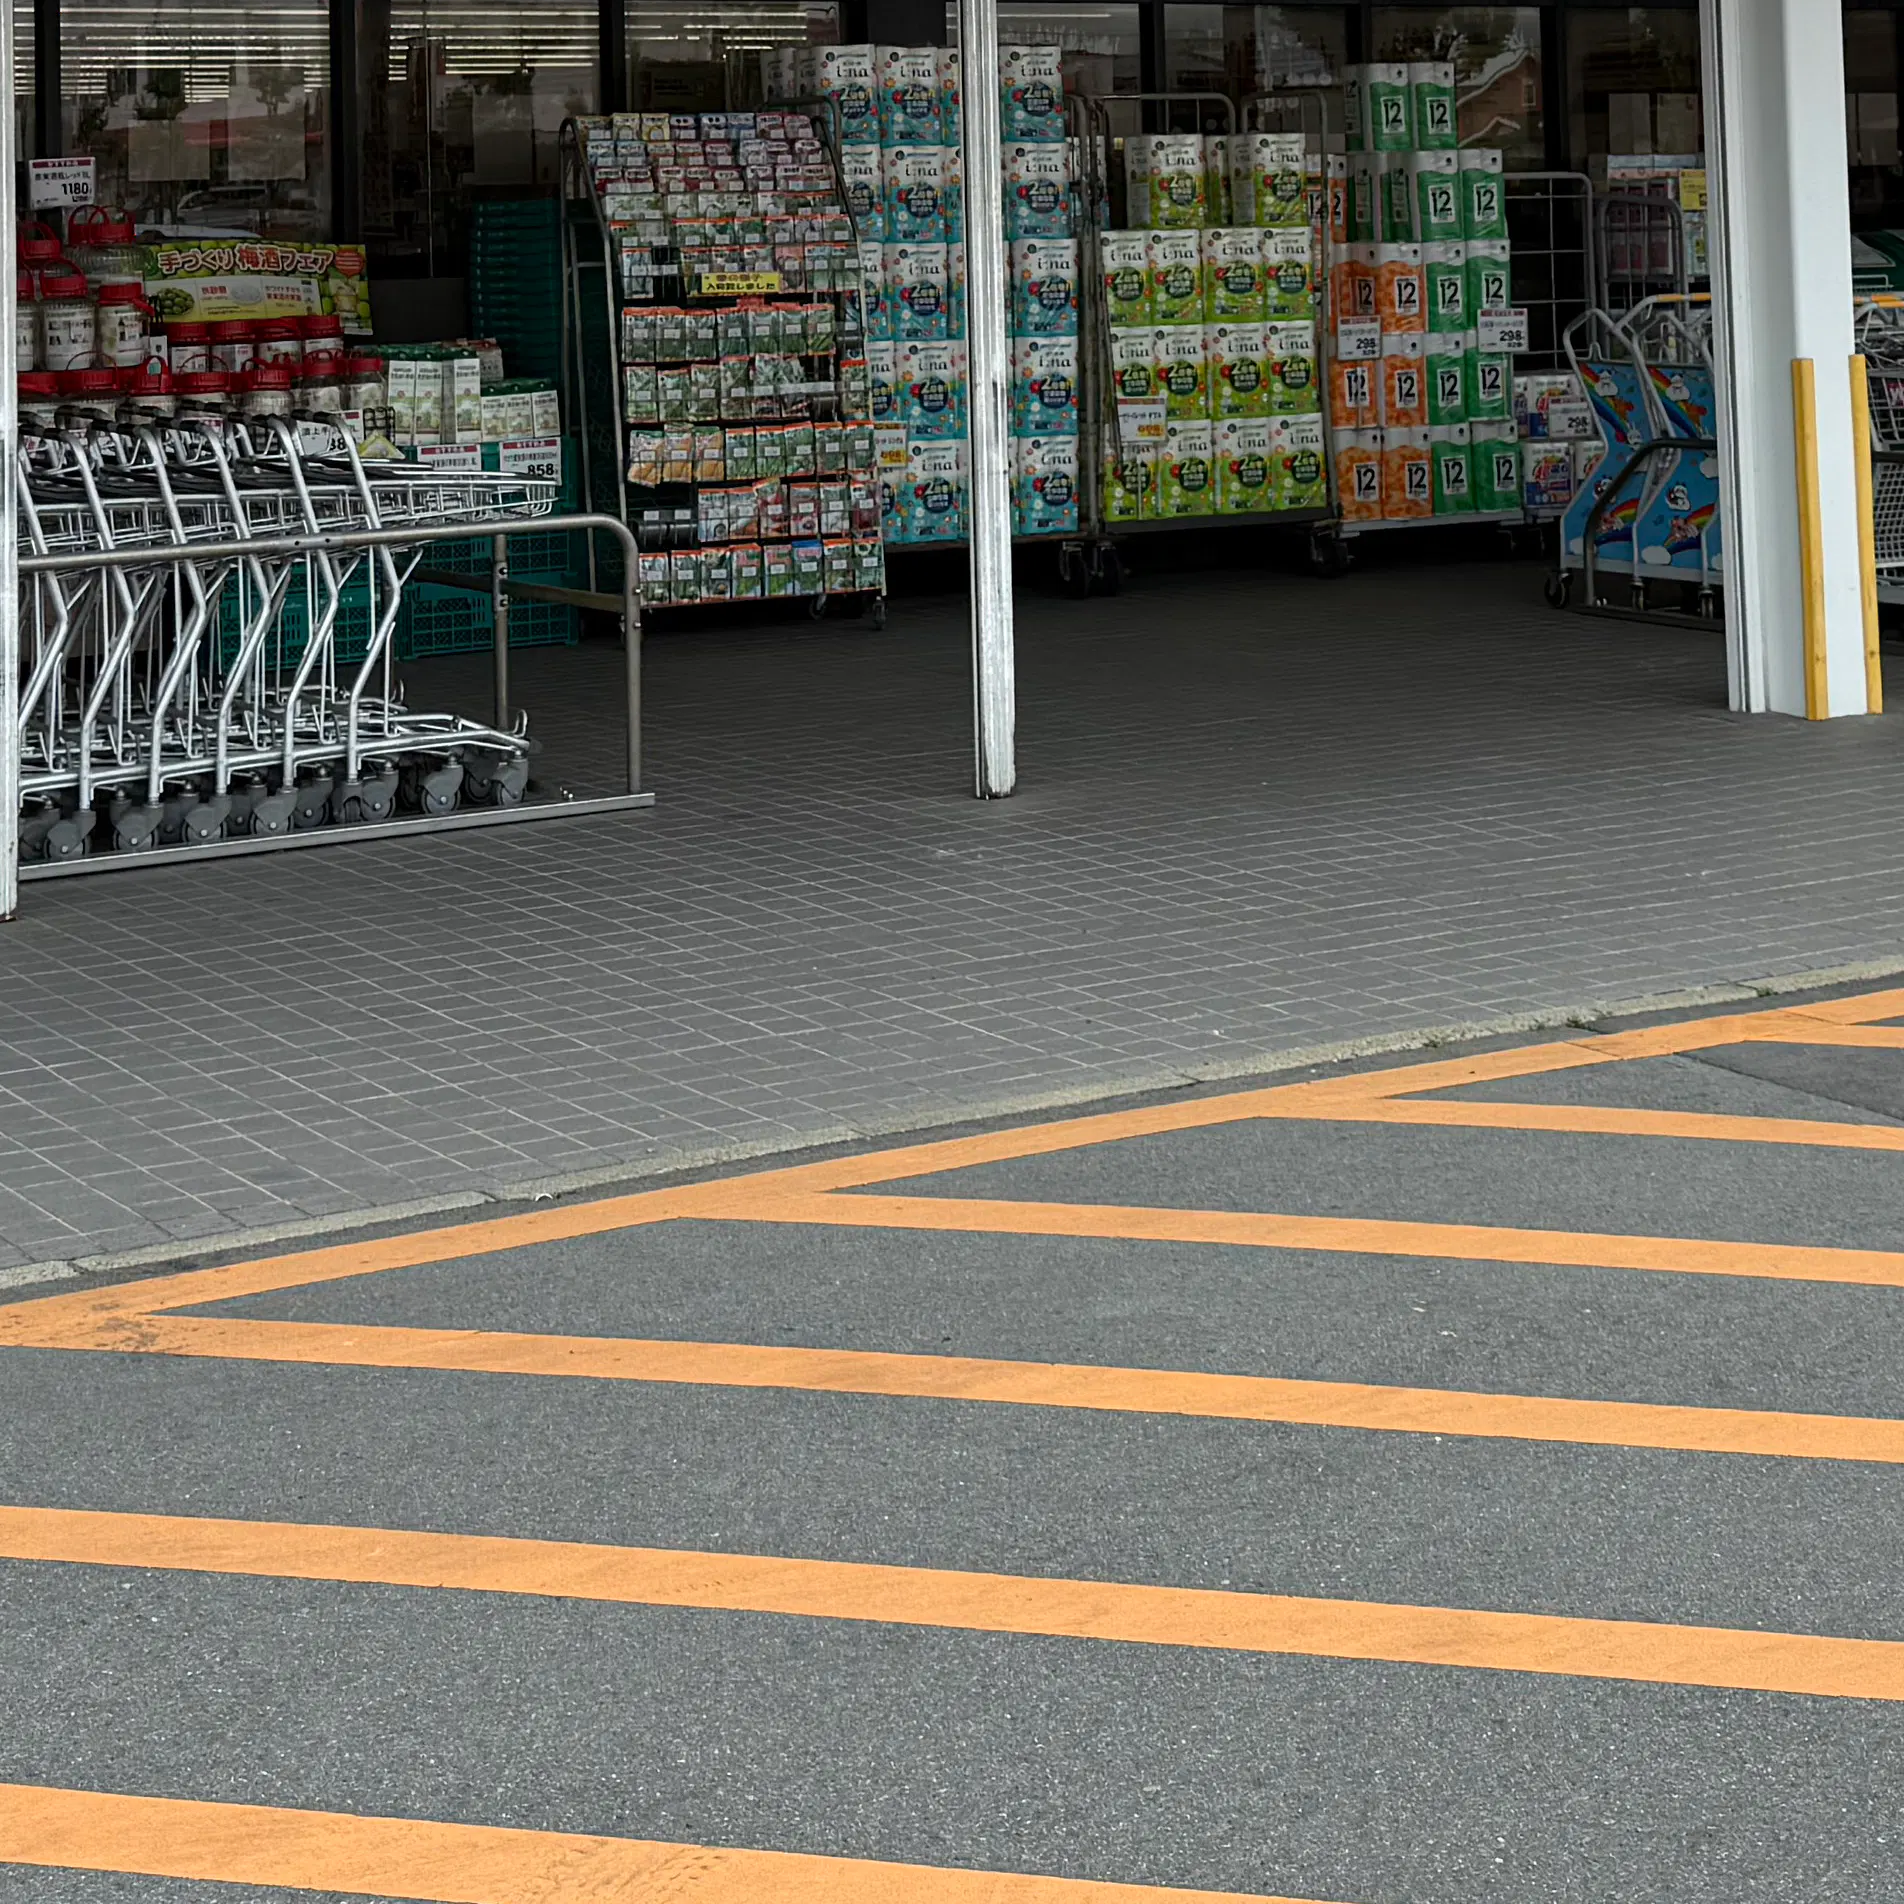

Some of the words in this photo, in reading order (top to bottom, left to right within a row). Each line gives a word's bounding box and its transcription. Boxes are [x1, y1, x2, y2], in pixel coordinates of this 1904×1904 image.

[1384, 102, 1402, 128] 12
[1429, 103, 1448, 128] 12
[62, 182, 89, 195] 1180
[1432, 190, 1453, 216] 12
[1476, 189, 1495, 215] 12
[1358, 283, 1373, 309] 12
[1398, 282, 1417, 308] 12
[1440, 281, 1460, 309] 12
[1485, 277, 1504, 304] 12
[1399, 375, 1416, 402] 12
[1441, 373, 1459, 402] 12
[1481, 368, 1501, 395] 12
[1356, 467, 1376, 495] 12
[1408, 467, 1427, 493] 12
[1445, 461, 1465, 488] 12
[1496, 459, 1514, 485] 12
